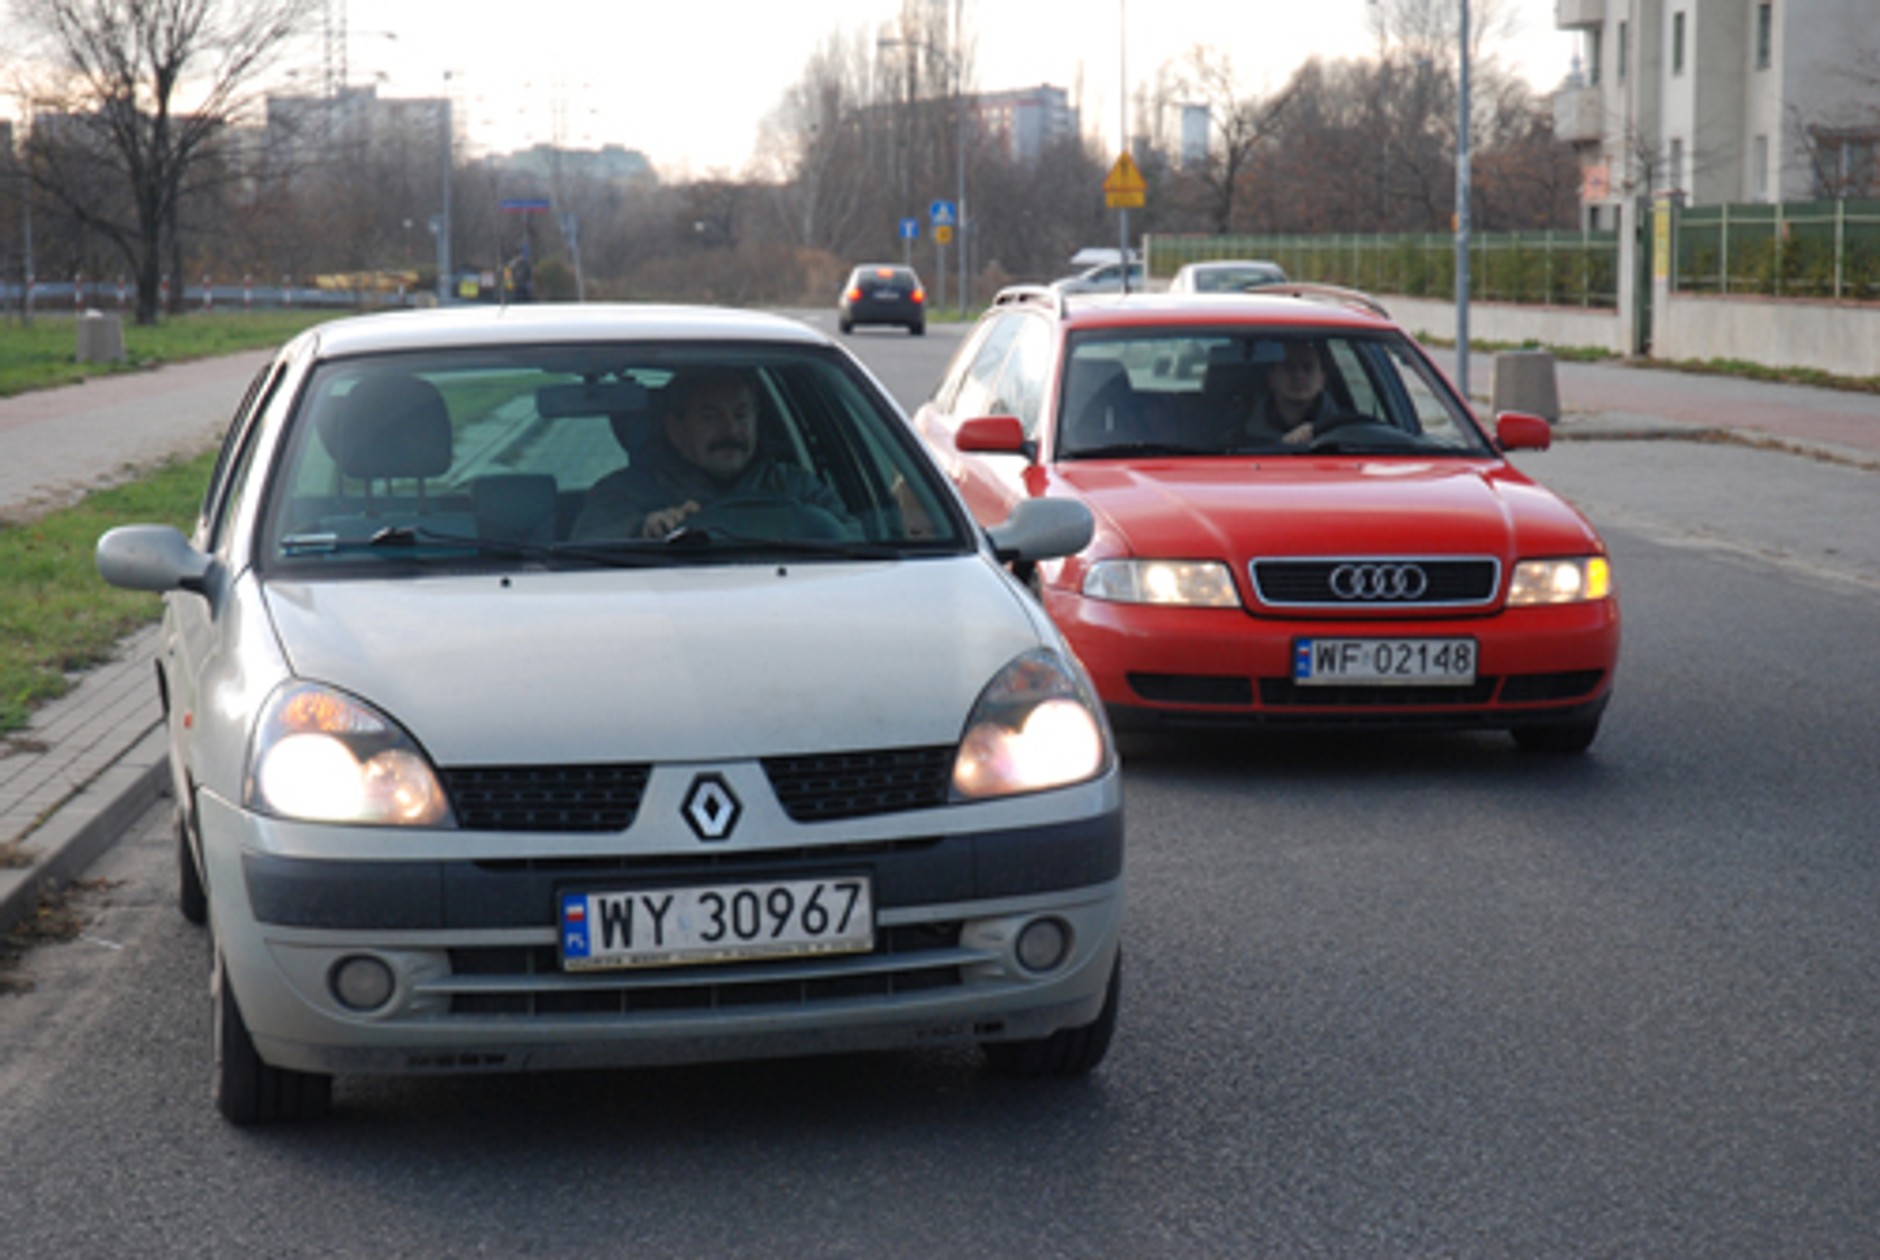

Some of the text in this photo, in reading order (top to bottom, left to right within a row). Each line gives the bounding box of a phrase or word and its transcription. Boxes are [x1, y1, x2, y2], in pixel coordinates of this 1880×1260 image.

[1316, 643, 1471, 674] WF 02148
[599, 883, 862, 949] WY 30967
